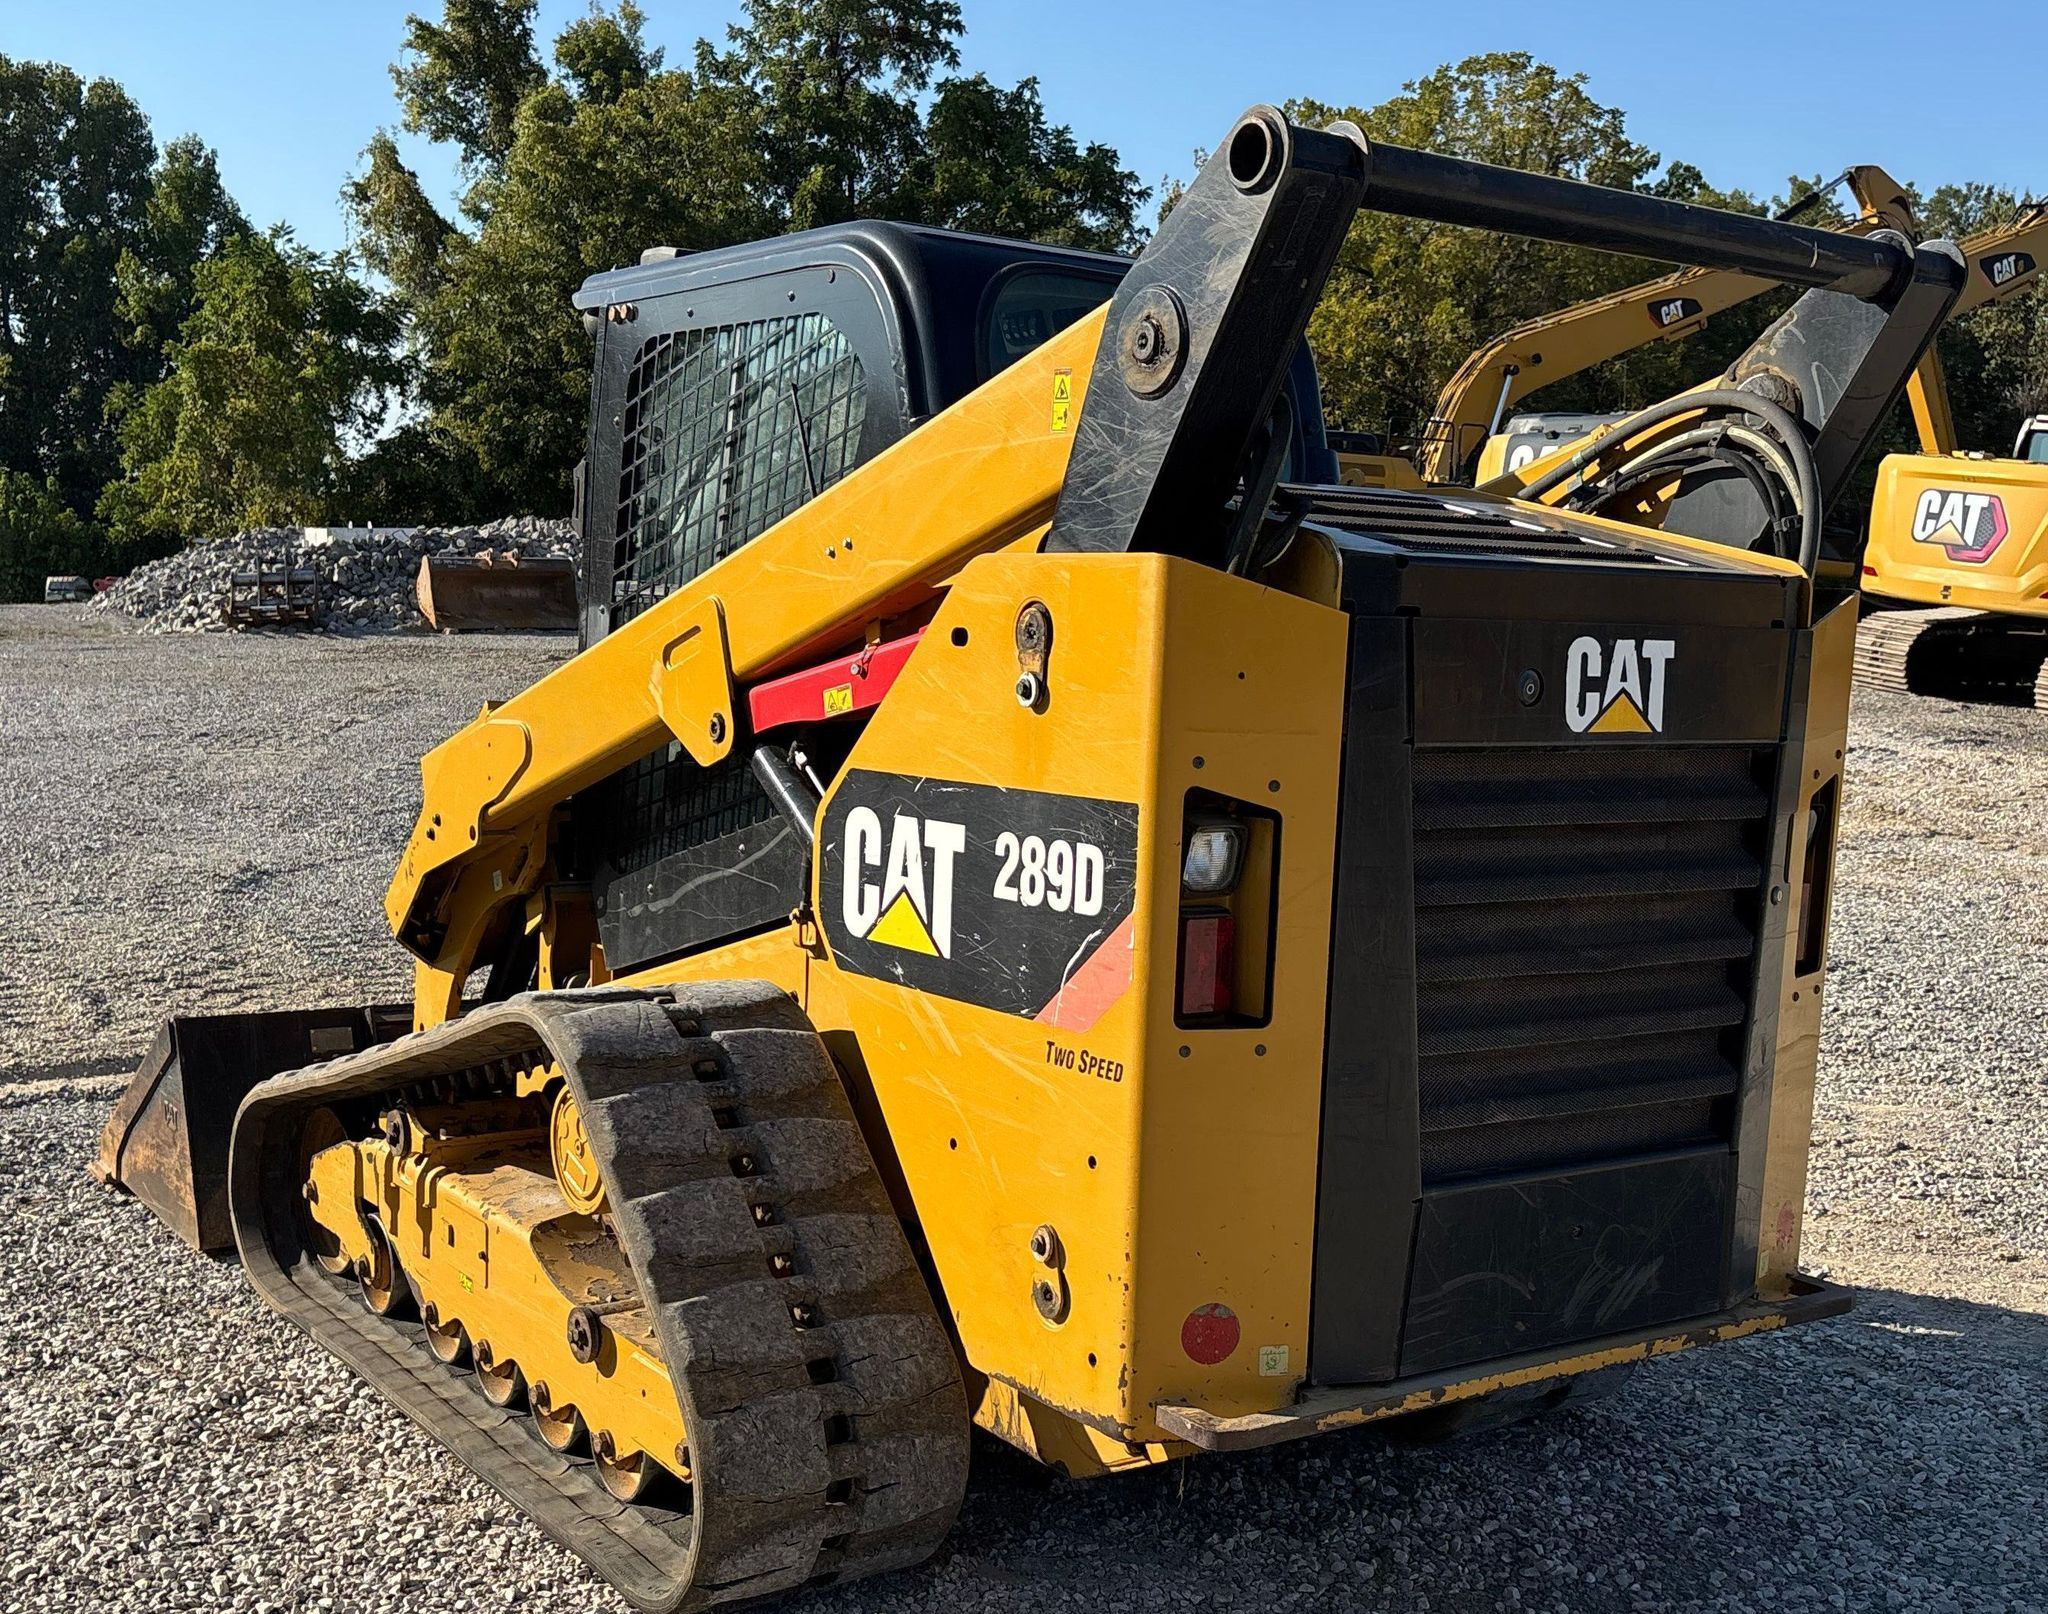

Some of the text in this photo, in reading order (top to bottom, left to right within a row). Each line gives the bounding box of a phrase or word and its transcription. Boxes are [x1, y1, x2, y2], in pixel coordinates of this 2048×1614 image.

[1993, 254, 2016, 285] CAT
[1660, 299, 1684, 325] CAT
[1912, 489, 1990, 547] CAT
[1565, 635, 1675, 733] CAT
[842, 805, 1105, 960] CAT 289D
